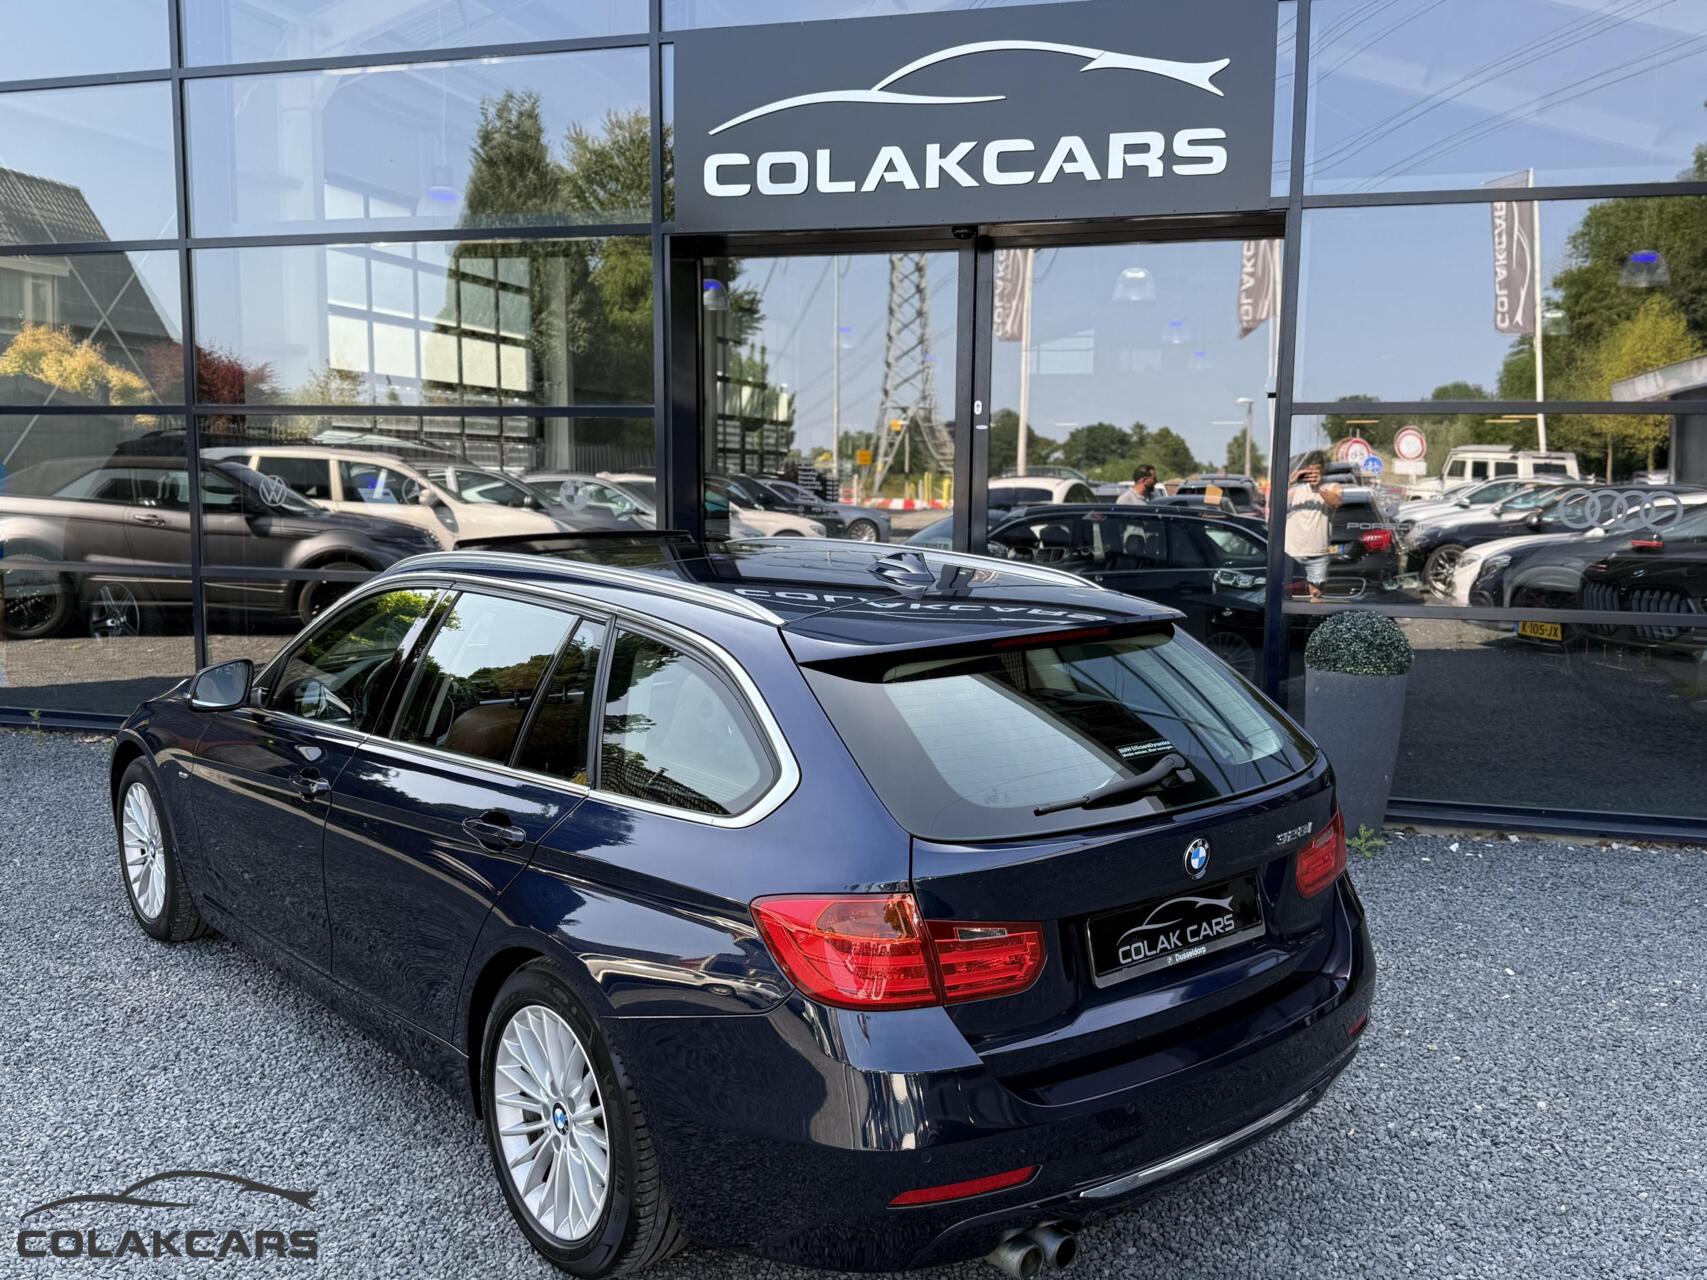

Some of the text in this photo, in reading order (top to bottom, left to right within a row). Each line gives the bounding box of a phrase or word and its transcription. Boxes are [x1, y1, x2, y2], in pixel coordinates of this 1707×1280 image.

[703, 128, 1228, 197] COLAKCARS
[1521, 620, 1559, 638] K-105-JX
[1118, 913, 1235, 965] COLAK CARS
[1174, 946, 1207, 962] Dusseldorp
